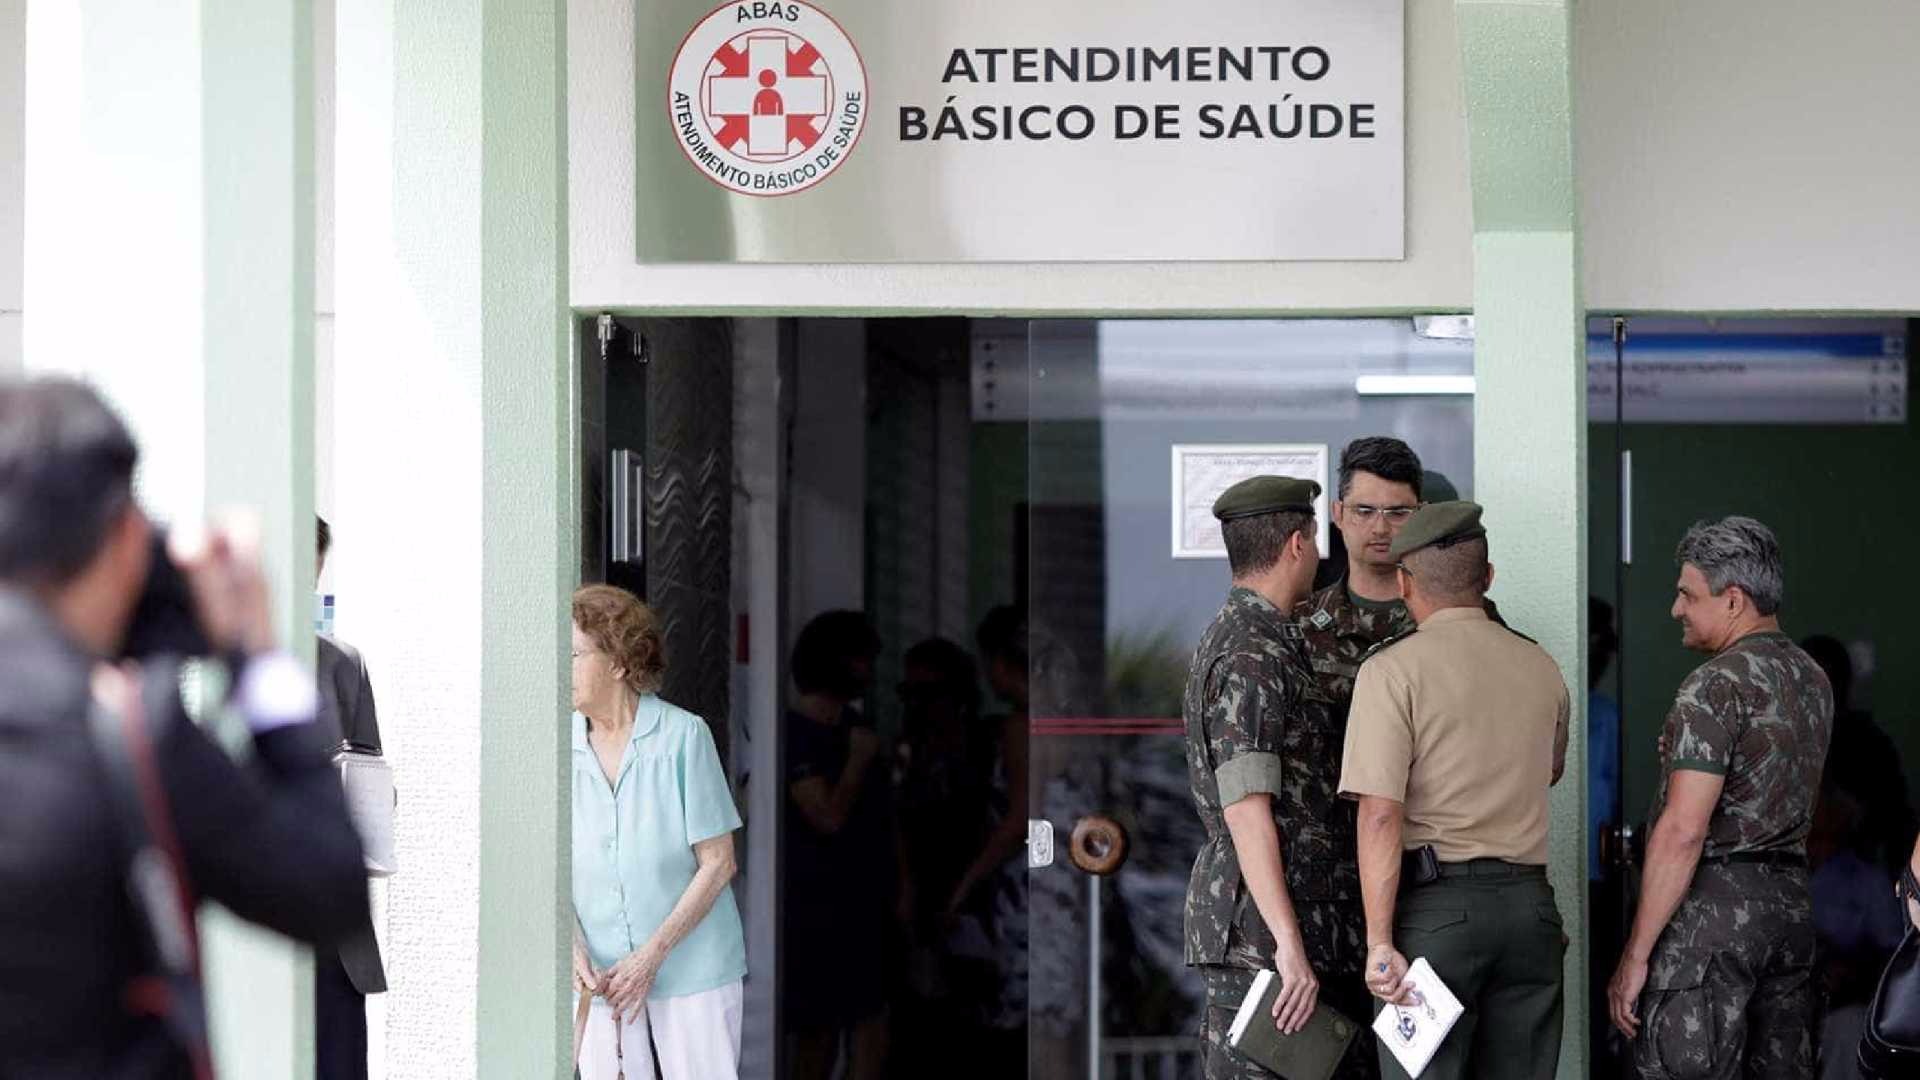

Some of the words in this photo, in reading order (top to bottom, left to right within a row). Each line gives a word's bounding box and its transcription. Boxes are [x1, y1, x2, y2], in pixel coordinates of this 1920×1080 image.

[737, 2, 800, 23] ABAS
[942, 46, 1331, 83] ATENDIMENTO
[899, 95, 1096, 141] BÁSICO
[1114, 105, 1181, 139] DE
[1199, 94, 1375, 139] SAÚDE
[674, 91, 751, 187] ATENDIMENTO
[753, 163, 817, 189] BÁSICO
[815, 146, 839, 170] DE
[833, 91, 861, 149] SAÚDE
